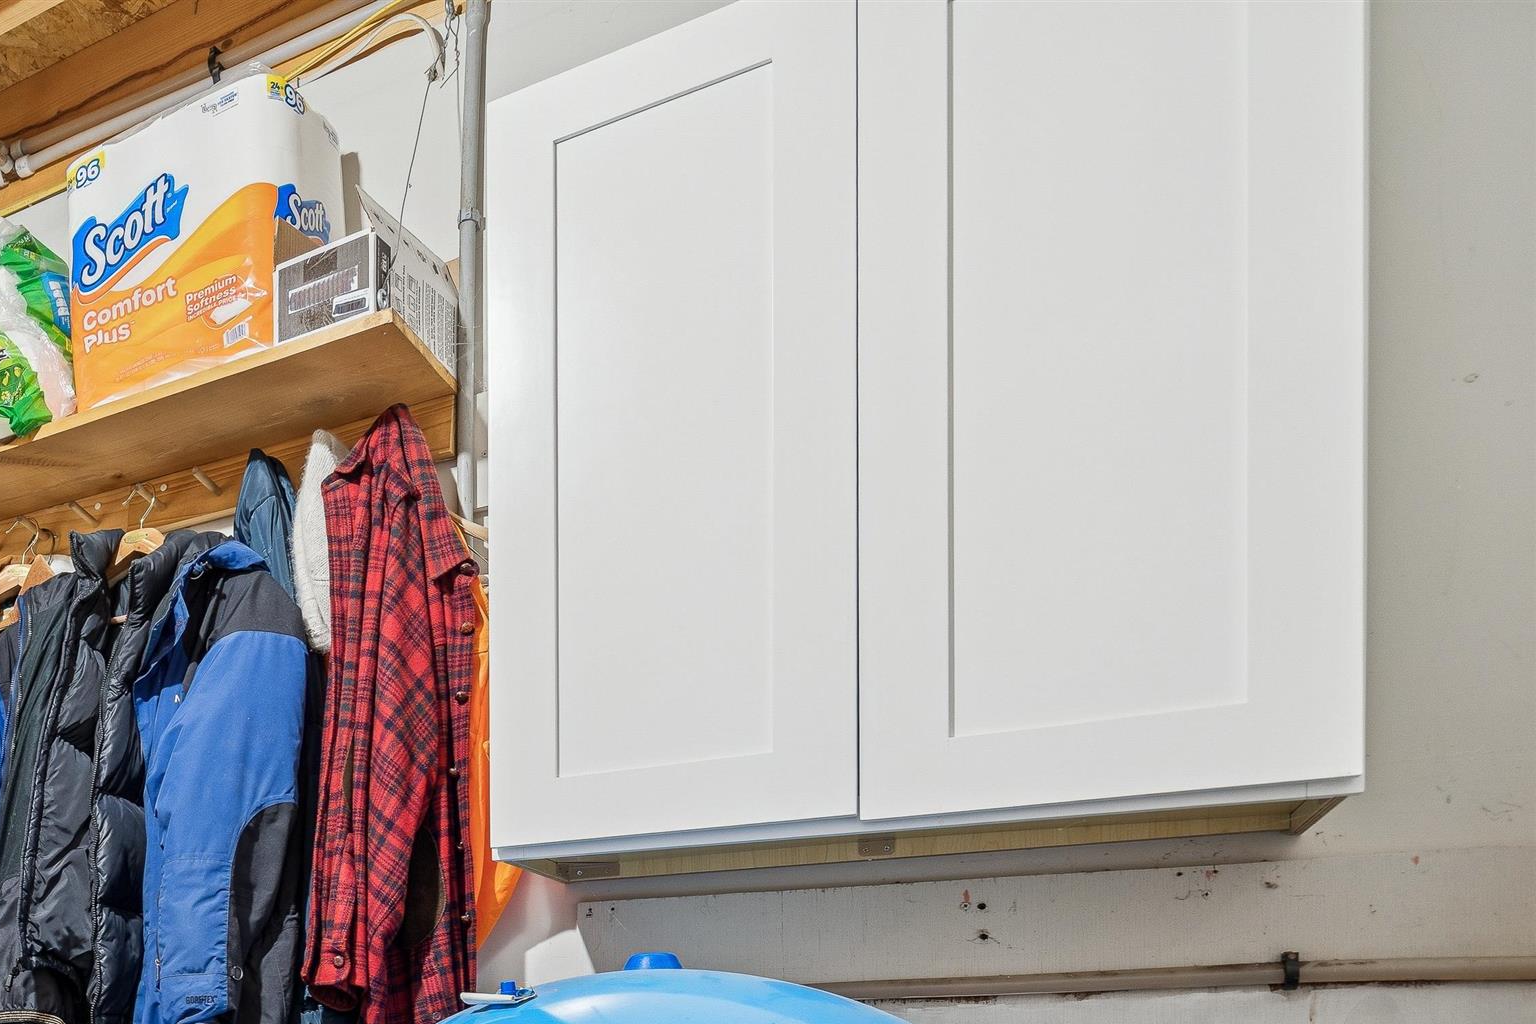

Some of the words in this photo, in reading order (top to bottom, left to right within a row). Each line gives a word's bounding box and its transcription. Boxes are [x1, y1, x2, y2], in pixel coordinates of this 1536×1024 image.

[284, 83, 306, 115] 96
[76, 159, 101, 189] 96
[286, 193, 325, 233] Scott
[80, 173, 170, 287] Scott
[82, 276, 178, 332] Comfort
[184, 274, 237, 306] Premium
[186, 287, 237, 315] Softness
[83, 322, 132, 354] Plus
